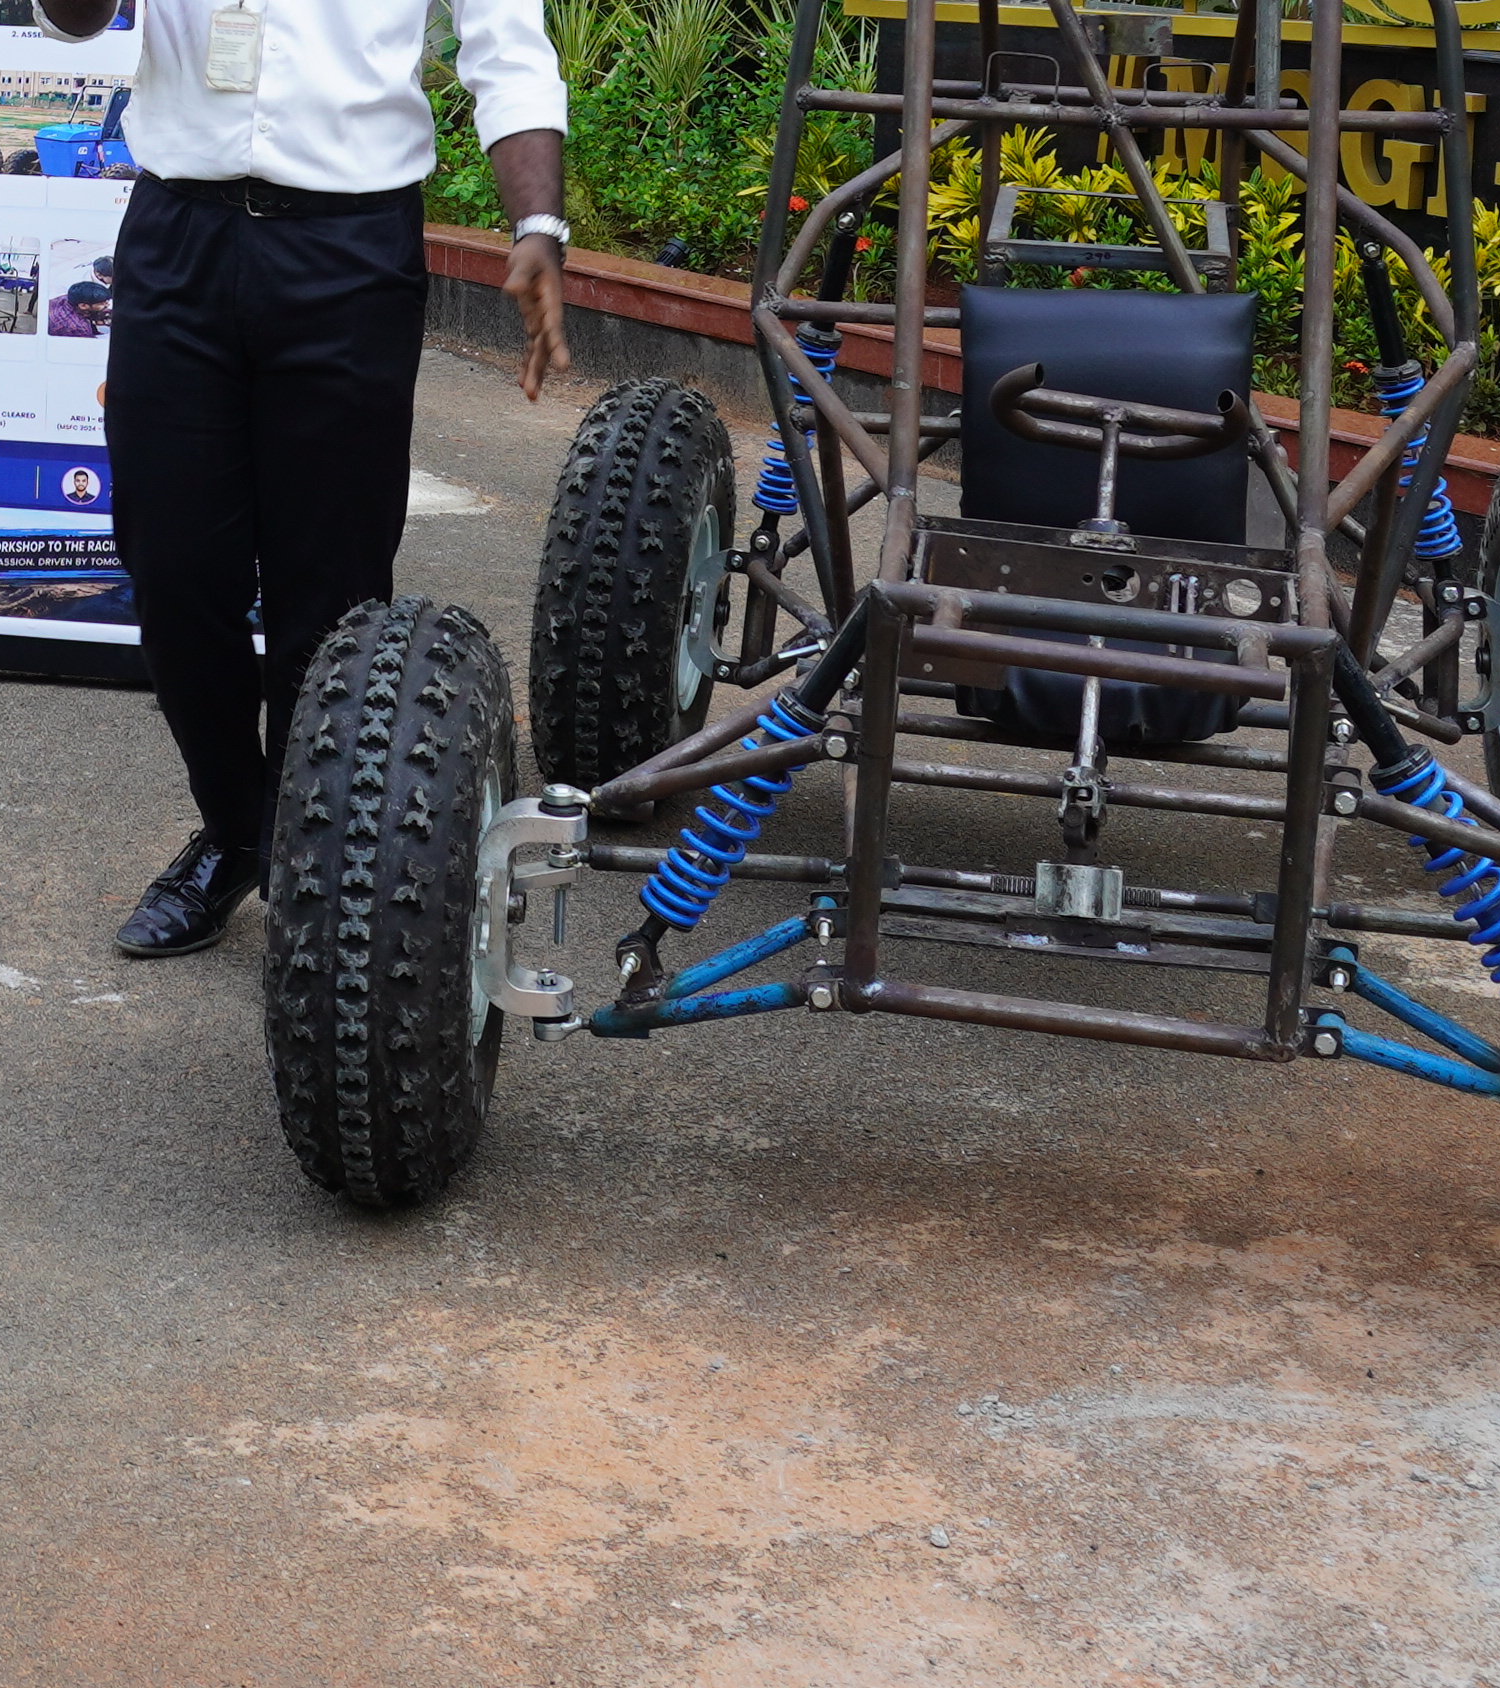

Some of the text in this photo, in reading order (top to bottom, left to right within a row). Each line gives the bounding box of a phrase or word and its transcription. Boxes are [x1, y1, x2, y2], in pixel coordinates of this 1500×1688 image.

[1, 410, 36, 419] CLEARED
[47, 540, 63, 552] TO
[64, 540, 86, 552] THE
[38, 557, 72, 566] DRIVEN
[75, 557, 88, 566] BY
